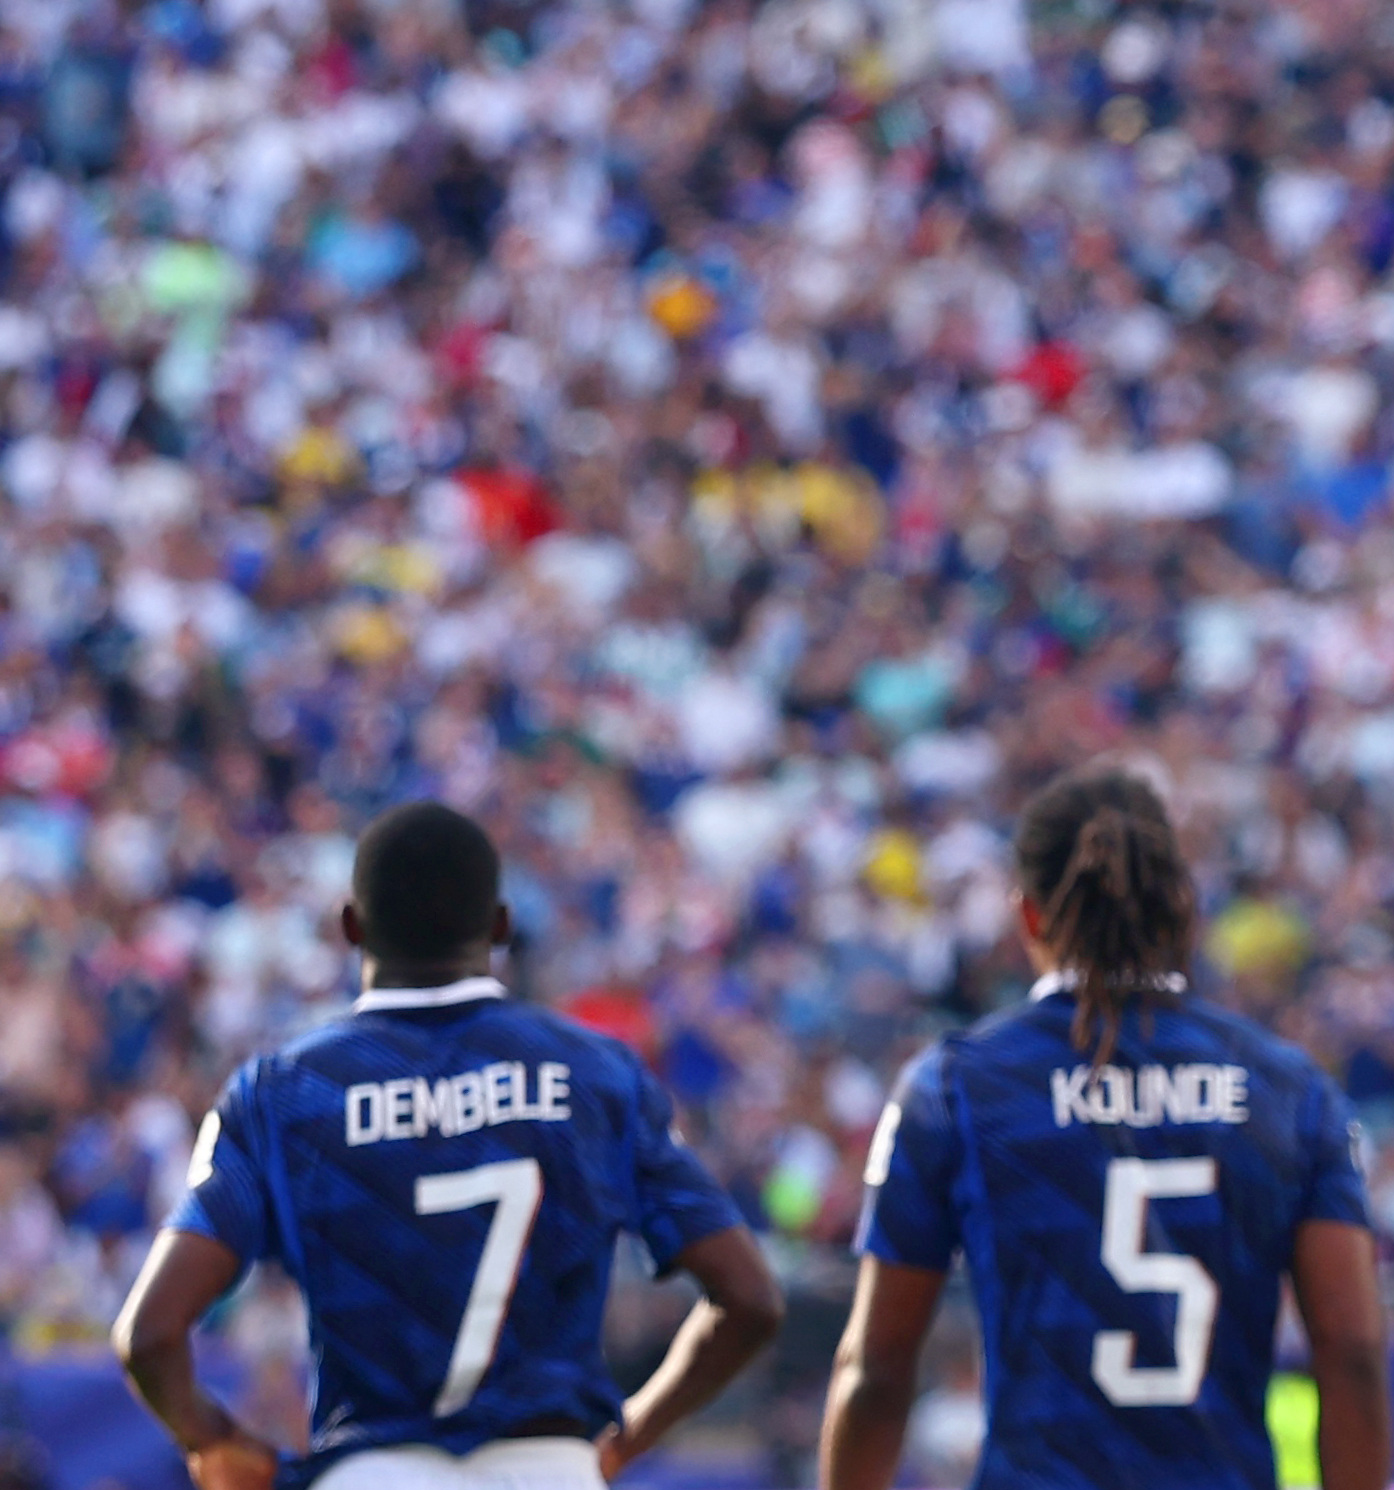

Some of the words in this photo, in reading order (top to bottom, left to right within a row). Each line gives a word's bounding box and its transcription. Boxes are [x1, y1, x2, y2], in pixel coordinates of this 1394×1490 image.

[345, 1060, 571, 1147] DEMBELE
[1052, 1063, 1249, 1128] KOUNDE
[414, 1156, 544, 1418] 7
[1091, 1155, 1221, 1407] 5
